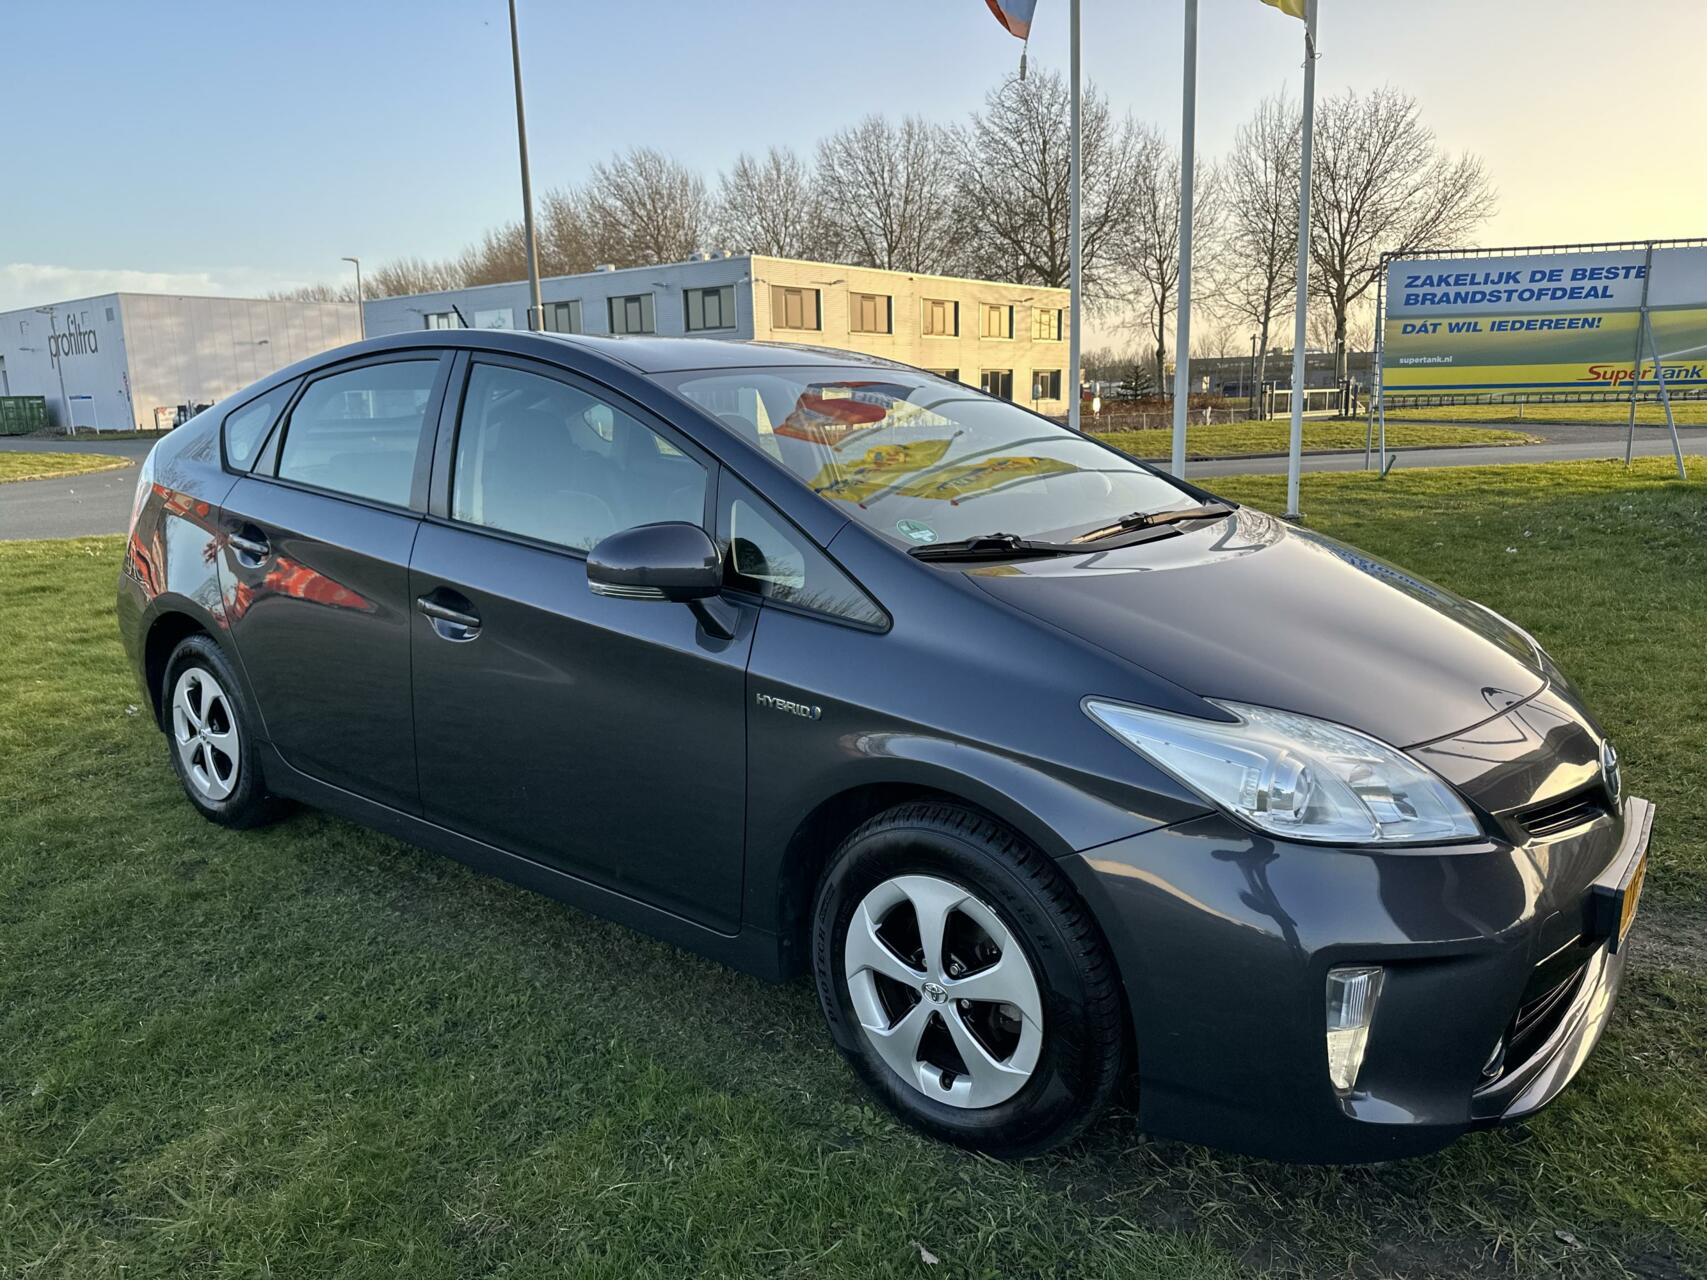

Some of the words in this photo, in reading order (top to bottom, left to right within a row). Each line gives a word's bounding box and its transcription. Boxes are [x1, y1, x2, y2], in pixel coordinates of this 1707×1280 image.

[1403, 270, 1523, 289] ZAKELIJK
[1528, 268, 1564, 283] DE
[1570, 265, 1650, 282] BESTE
[1403, 285, 1614, 306] BRANDSTOFDEAL
[1401, 320, 1442, 335] DÁT
[1447, 320, 1483, 334] WIL
[1489, 317, 1602, 332] IEDEREEN!
[47, 313, 99, 369] profiltra
[1399, 355, 1453, 365] supertank.nl
[756, 693, 811, 718] HYBRID
